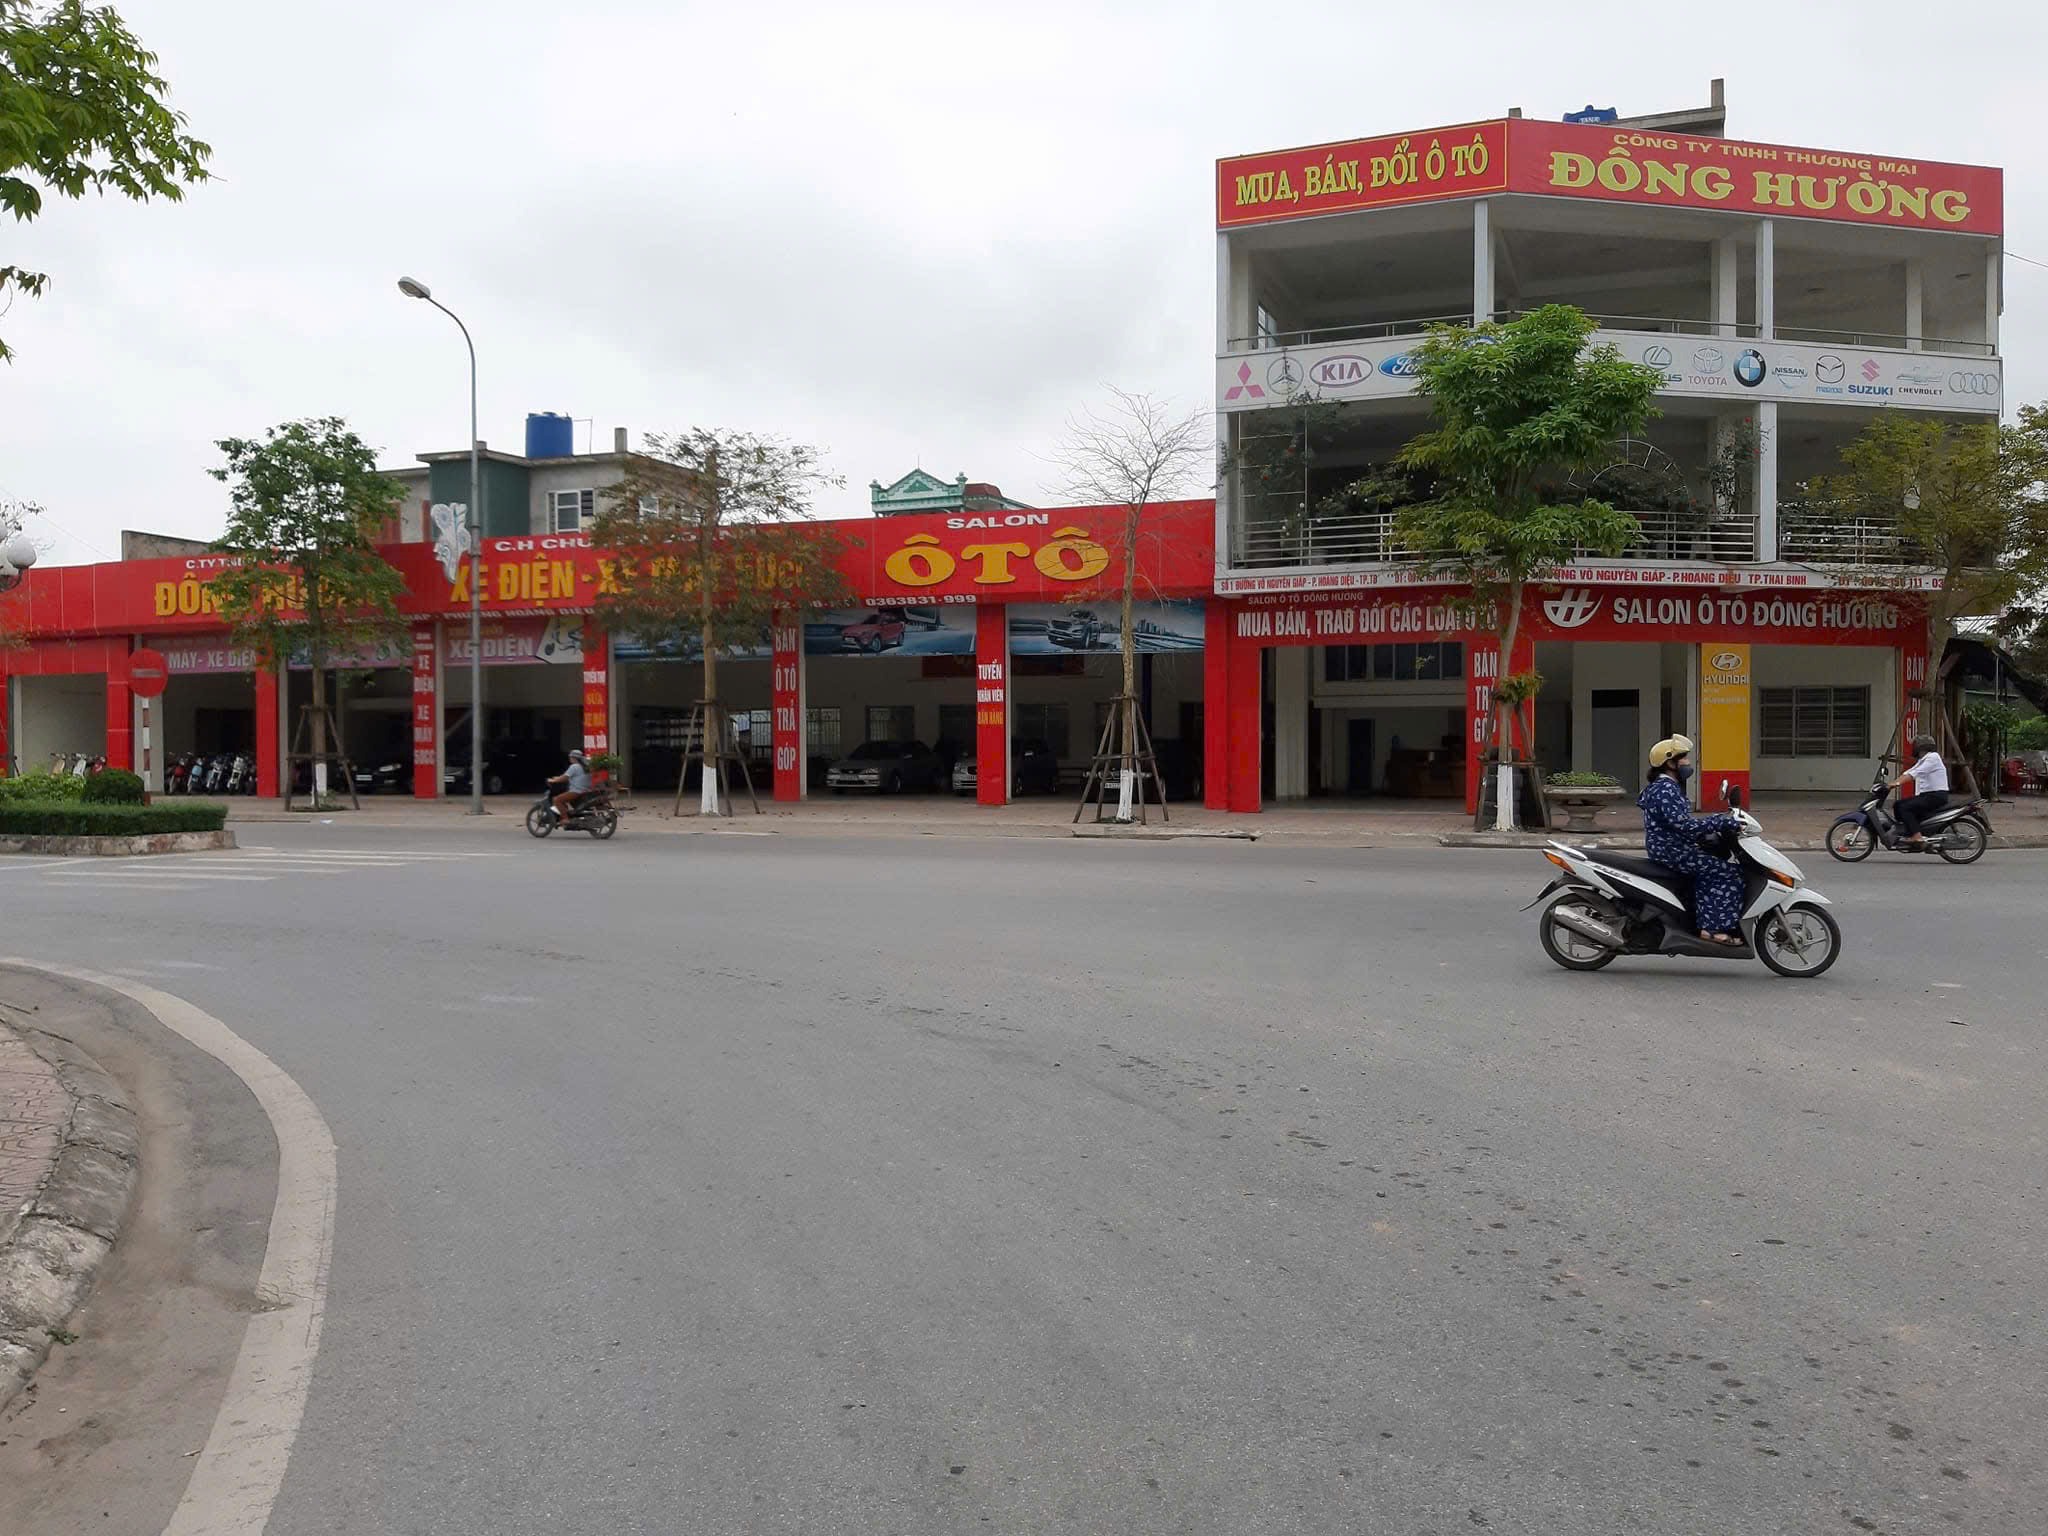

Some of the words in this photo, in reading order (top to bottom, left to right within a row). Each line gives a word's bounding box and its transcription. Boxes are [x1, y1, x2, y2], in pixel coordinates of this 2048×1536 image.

[1613, 132, 1677, 151] CÔNG
[1685, 142, 1713, 154] TY
[1719, 145, 1777, 161] TNHH
[1783, 151, 1873, 171] THƯƠNG
[1878, 161, 1918, 177] MẠI
[1235, 171, 1300, 205] MUA,
[1304, 153, 1364, 196] BÁN,
[1370, 138, 1419, 187] ĐỔI
[1425, 138, 1447, 180] Ô
[1451, 132, 1490, 176] TÔ
[1547, 147, 1736, 199] ĐÔNG
[1752, 171, 1972, 223] HƯỜNG
[1321, 362, 1363, 382] KIA
[1688, 375, 1728, 386] TOYOTA
[1774, 366, 1805, 375] NISSAN
[1847, 384, 1894, 396] SUZUKI
[1898, 387, 1943, 396] CHEVROLET
[946, 513, 1049, 530] SALON
[498, 552, 576, 607] ĐIỆN
[1596, 568, 1638, 581] NGUYÊN
[1247, 595, 1277, 606] SALON
[1613, 597, 1690, 625] SALON
[1697, 592, 1713, 625] Ô
[1717, 593, 1747, 625] TÔ
[1752, 596, 1816, 628] ĐÔNG
[1238, 611, 1271, 637] MUA
[1275, 605, 1312, 638] BÁN,
[1315, 609, 1354, 635] TRAO
[1359, 597, 1386, 633] ĐỔI
[1390, 602, 1422, 633] CÁC
[207, 650, 225, 668] XE
[977, 658, 1002, 680] TUYỂN
[1473, 648, 1497, 678] BÁN
[783, 663, 797, 692] TÔ
[1703, 674, 1750, 685] HYUNDAI
[776, 698, 796, 732] TRẢ
[776, 743, 797, 771] GÓP
